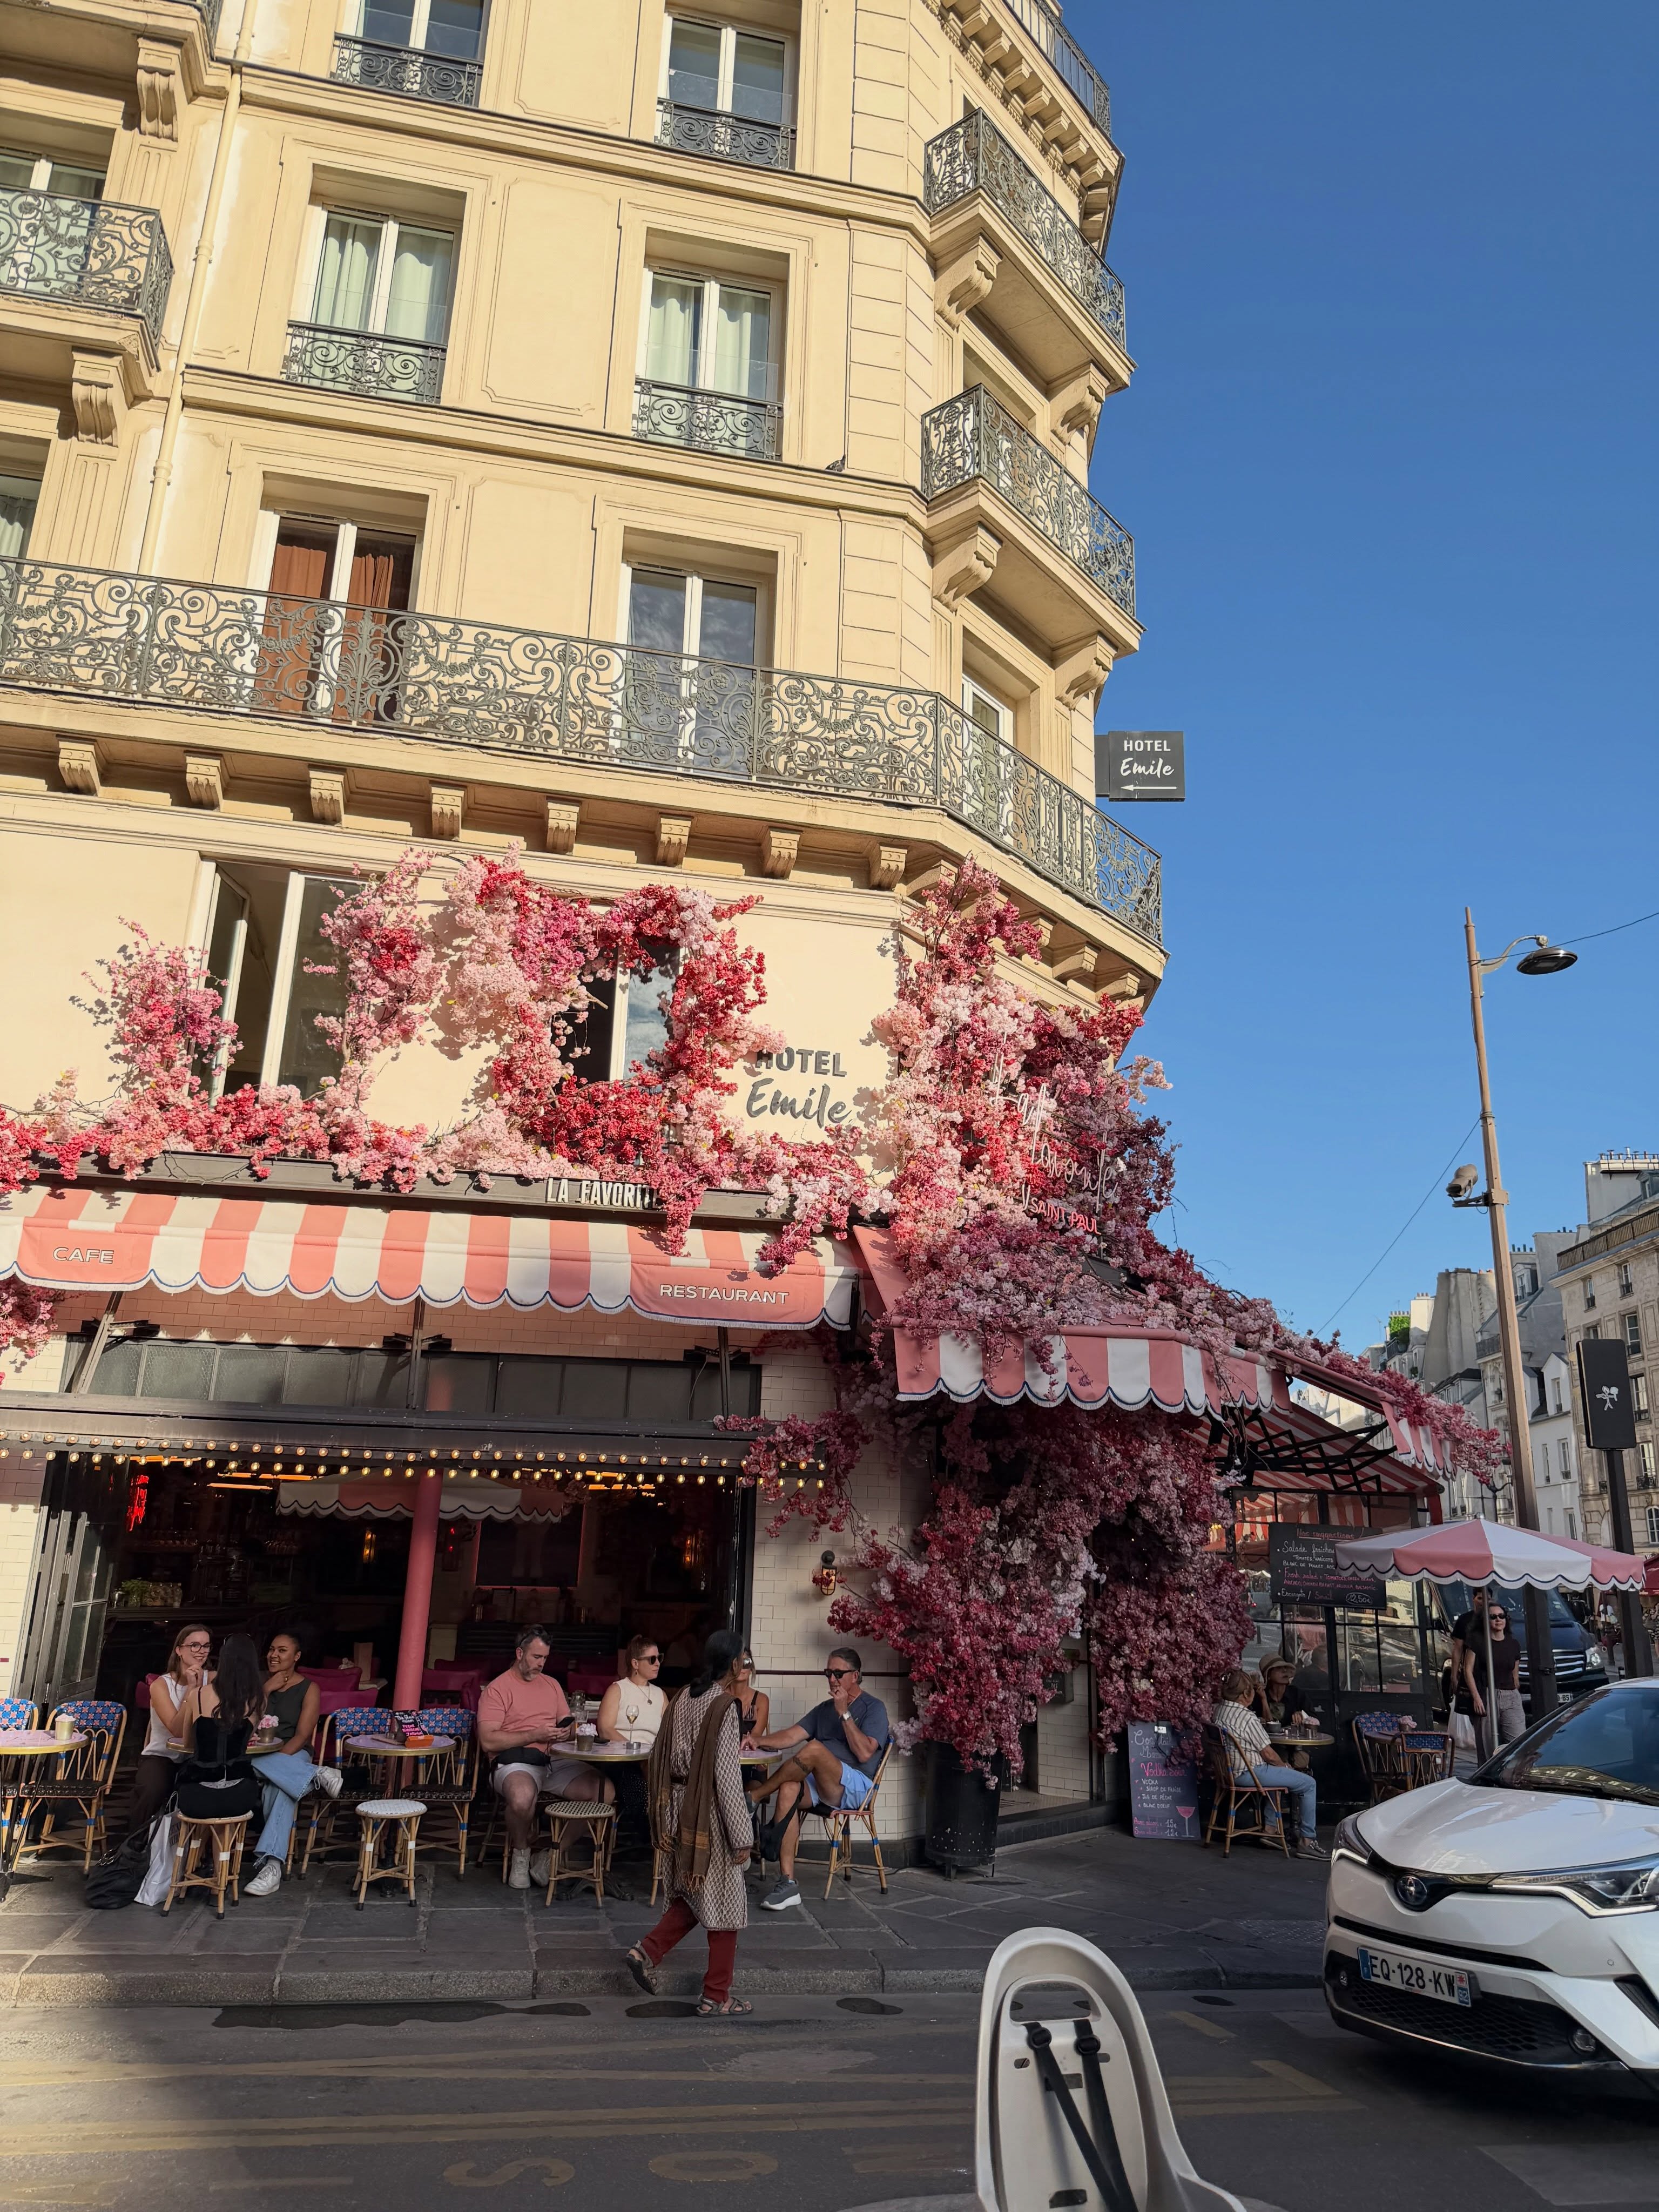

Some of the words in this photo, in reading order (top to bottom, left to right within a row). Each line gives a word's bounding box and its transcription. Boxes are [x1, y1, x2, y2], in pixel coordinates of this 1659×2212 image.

[1124, 740, 1171, 751] HOTEL
[1120, 758, 1175, 778] Emile
[755, 1047, 847, 1077] HOTEL
[746, 1078, 852, 1128] Emile
[545, 1178, 569, 1203] LA
[1030, 1197, 1066, 1222] SAINT
[1070, 1211, 1102, 1236] PAUL
[52, 1246, 114, 1264] CAFE
[659, 1283, 790, 1304] RESTAURANT
[1282, 1540, 1307, 1553] Salade
[1370, 1955, 1455, 1997] EQ-128-KW
